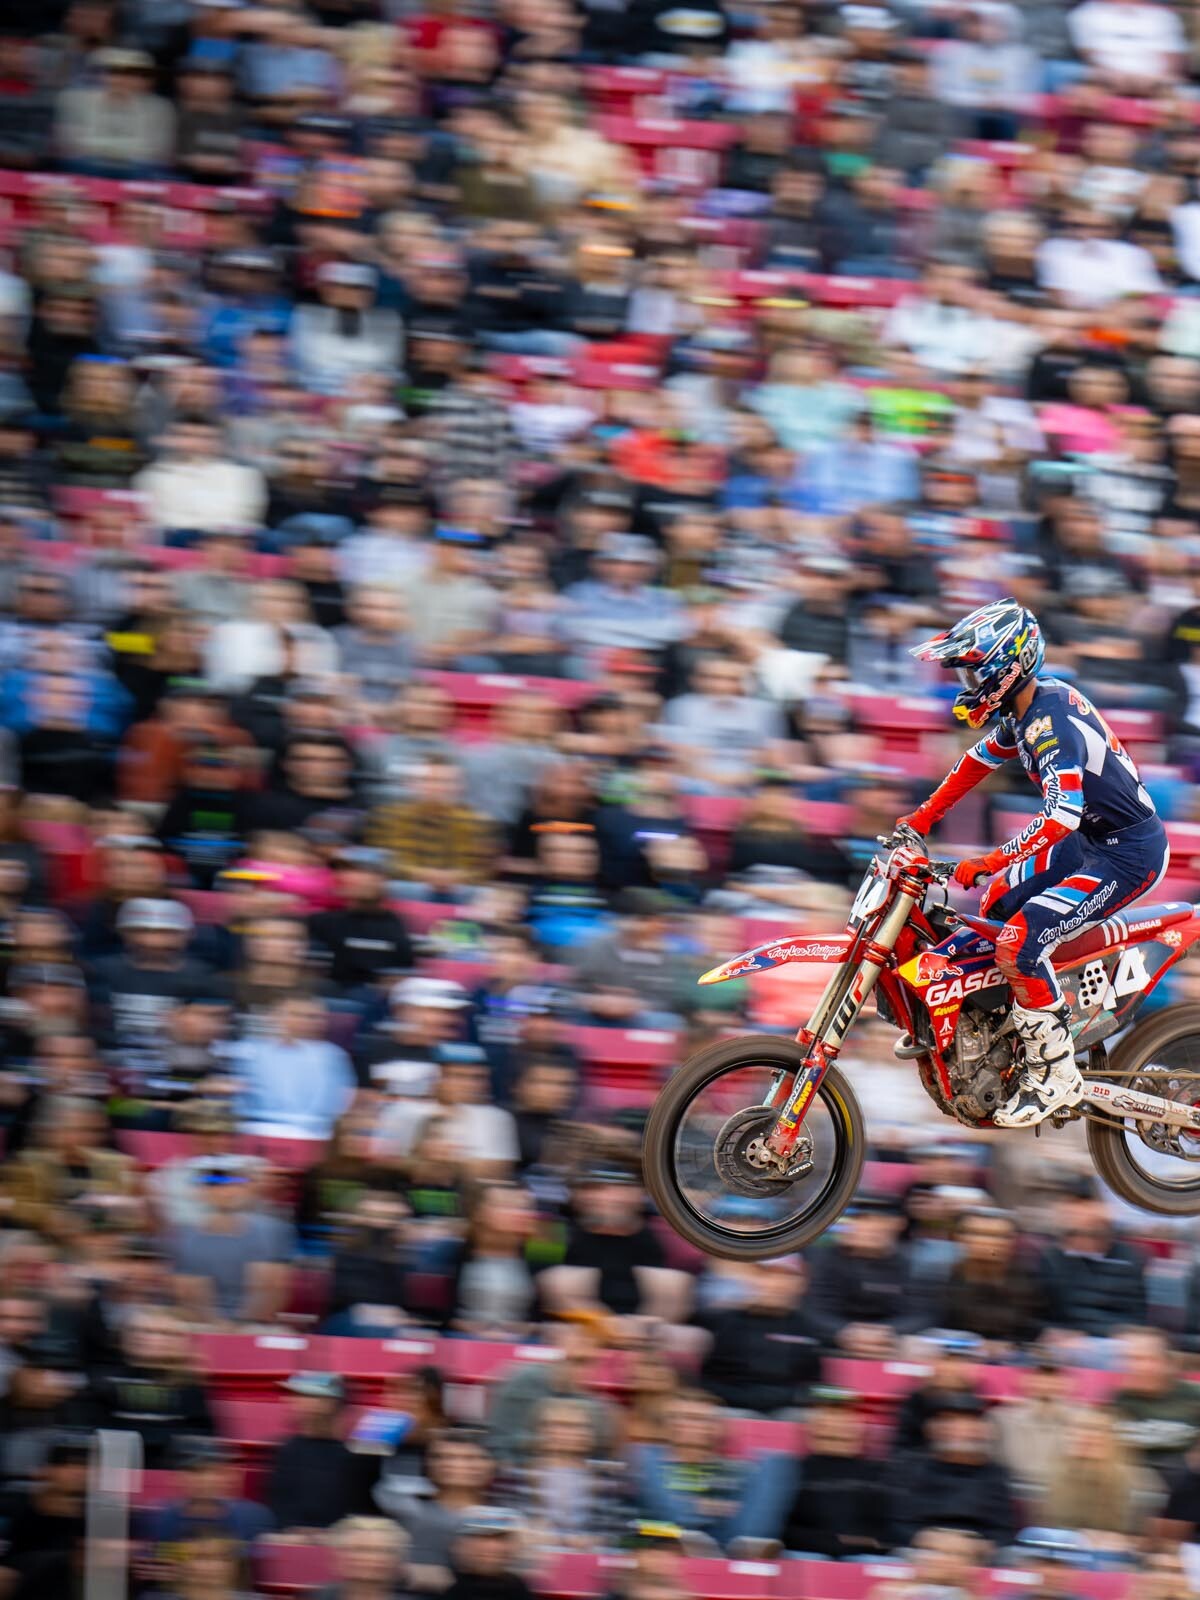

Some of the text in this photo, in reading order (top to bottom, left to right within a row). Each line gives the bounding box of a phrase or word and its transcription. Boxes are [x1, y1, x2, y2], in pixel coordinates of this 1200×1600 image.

[988, 661, 1021, 702] Red Bull
[1020, 817, 1043, 842] Lee
[1038, 926, 1061, 945] Troy
[1077, 880, 1118, 920] Designs
[1128, 918, 1162, 933] GASGAS
[767, 943, 848, 961] Troy Lee Designs
[1093, 1085, 1111, 1096] DID
